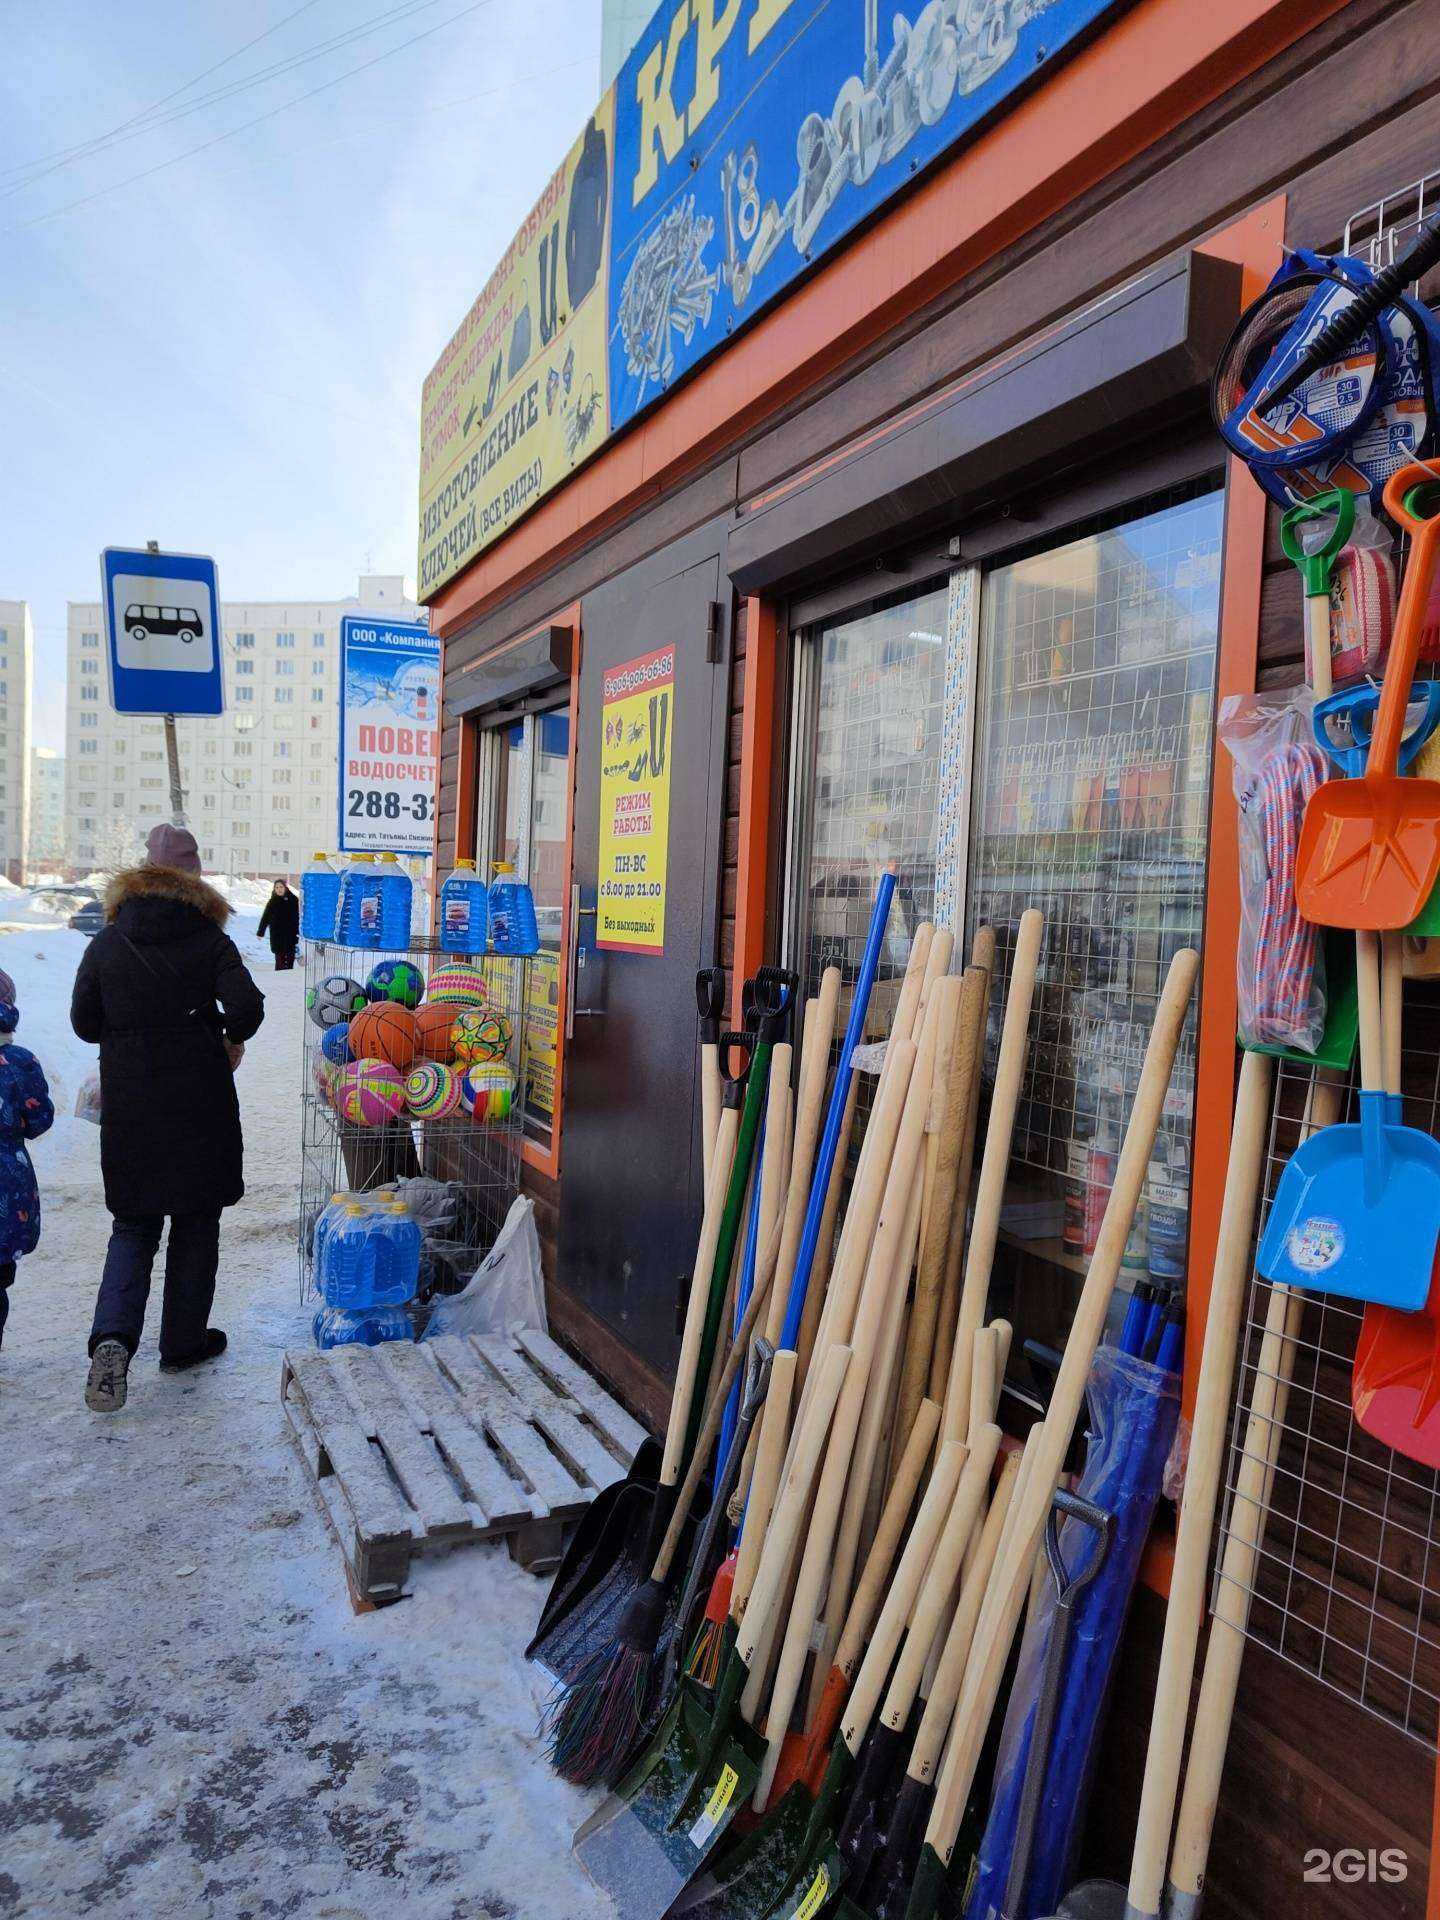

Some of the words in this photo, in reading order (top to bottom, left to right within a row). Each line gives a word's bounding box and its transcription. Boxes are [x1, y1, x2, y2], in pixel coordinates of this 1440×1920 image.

[633, 0, 795, 207] КР
[461, 292, 513, 387] ОДЕЖДЫ
[422, 379, 539, 543] ИЗГОТОВЛЕНИЕ
[421, 500, 478, 590] КЛЮЧЕЙ
[479, 493, 501, 539] (ВСЕ
[503, 456, 543, 517] ВИДЫ)
[352, 629, 376, 642] ООО
[349, 760, 435, 781] ВОДОСЧЕТ
[616, 792, 651, 812] РЕЖИМ
[613, 815, 652, 835] РАБОТЫ
[615, 854, 646, 873] ПН-ВС
[606, 880, 623, 896] 8.00
[624, 883, 635, 899] до
[637, 883, 661, 897] 21.00
[604, 916, 616, 930] Без
[617, 919, 655, 933] выходных
